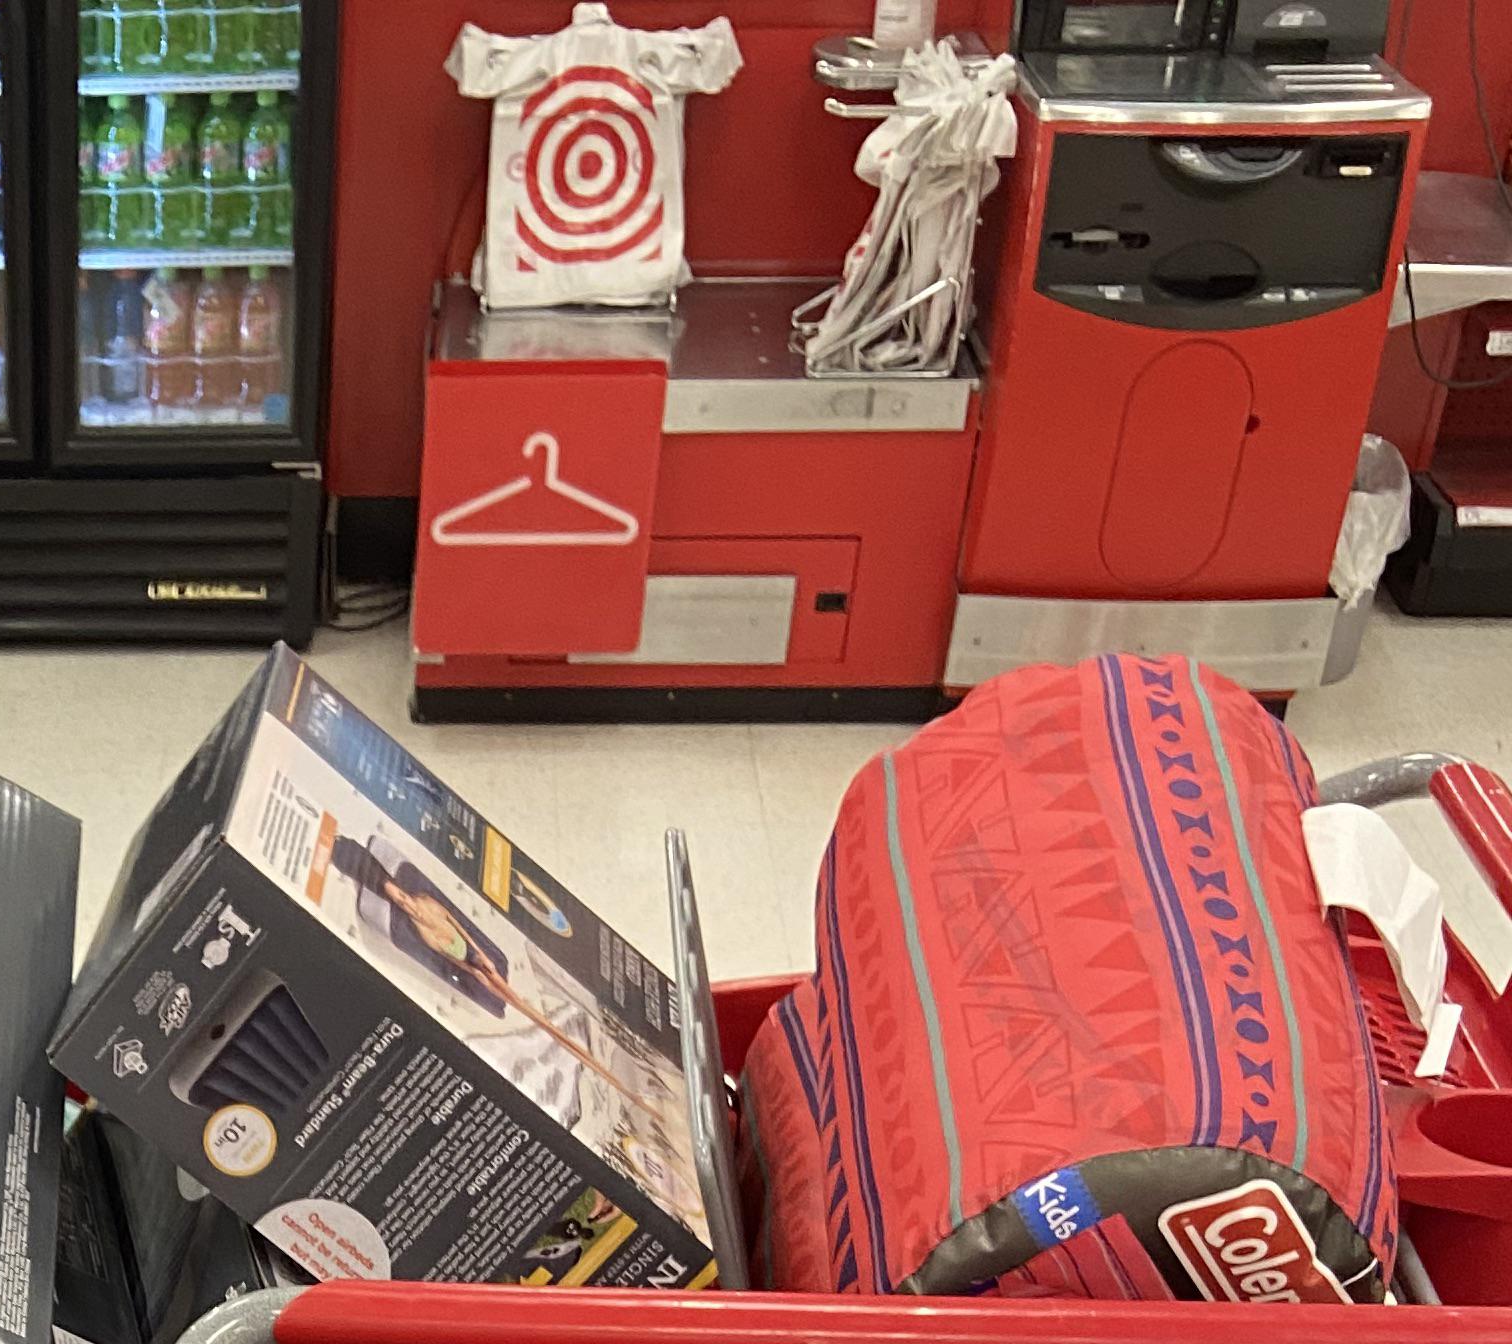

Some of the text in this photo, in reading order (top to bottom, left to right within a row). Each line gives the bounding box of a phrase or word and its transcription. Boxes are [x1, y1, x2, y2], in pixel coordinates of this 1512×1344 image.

[292, 1091, 345, 1149] Standard
[428, 1079, 475, 1128] Durable
[463, 1126, 531, 1199] Comfortable
[1023, 1172, 1079, 1242] Kids
[1202, 1205, 1300, 1305] Cole
